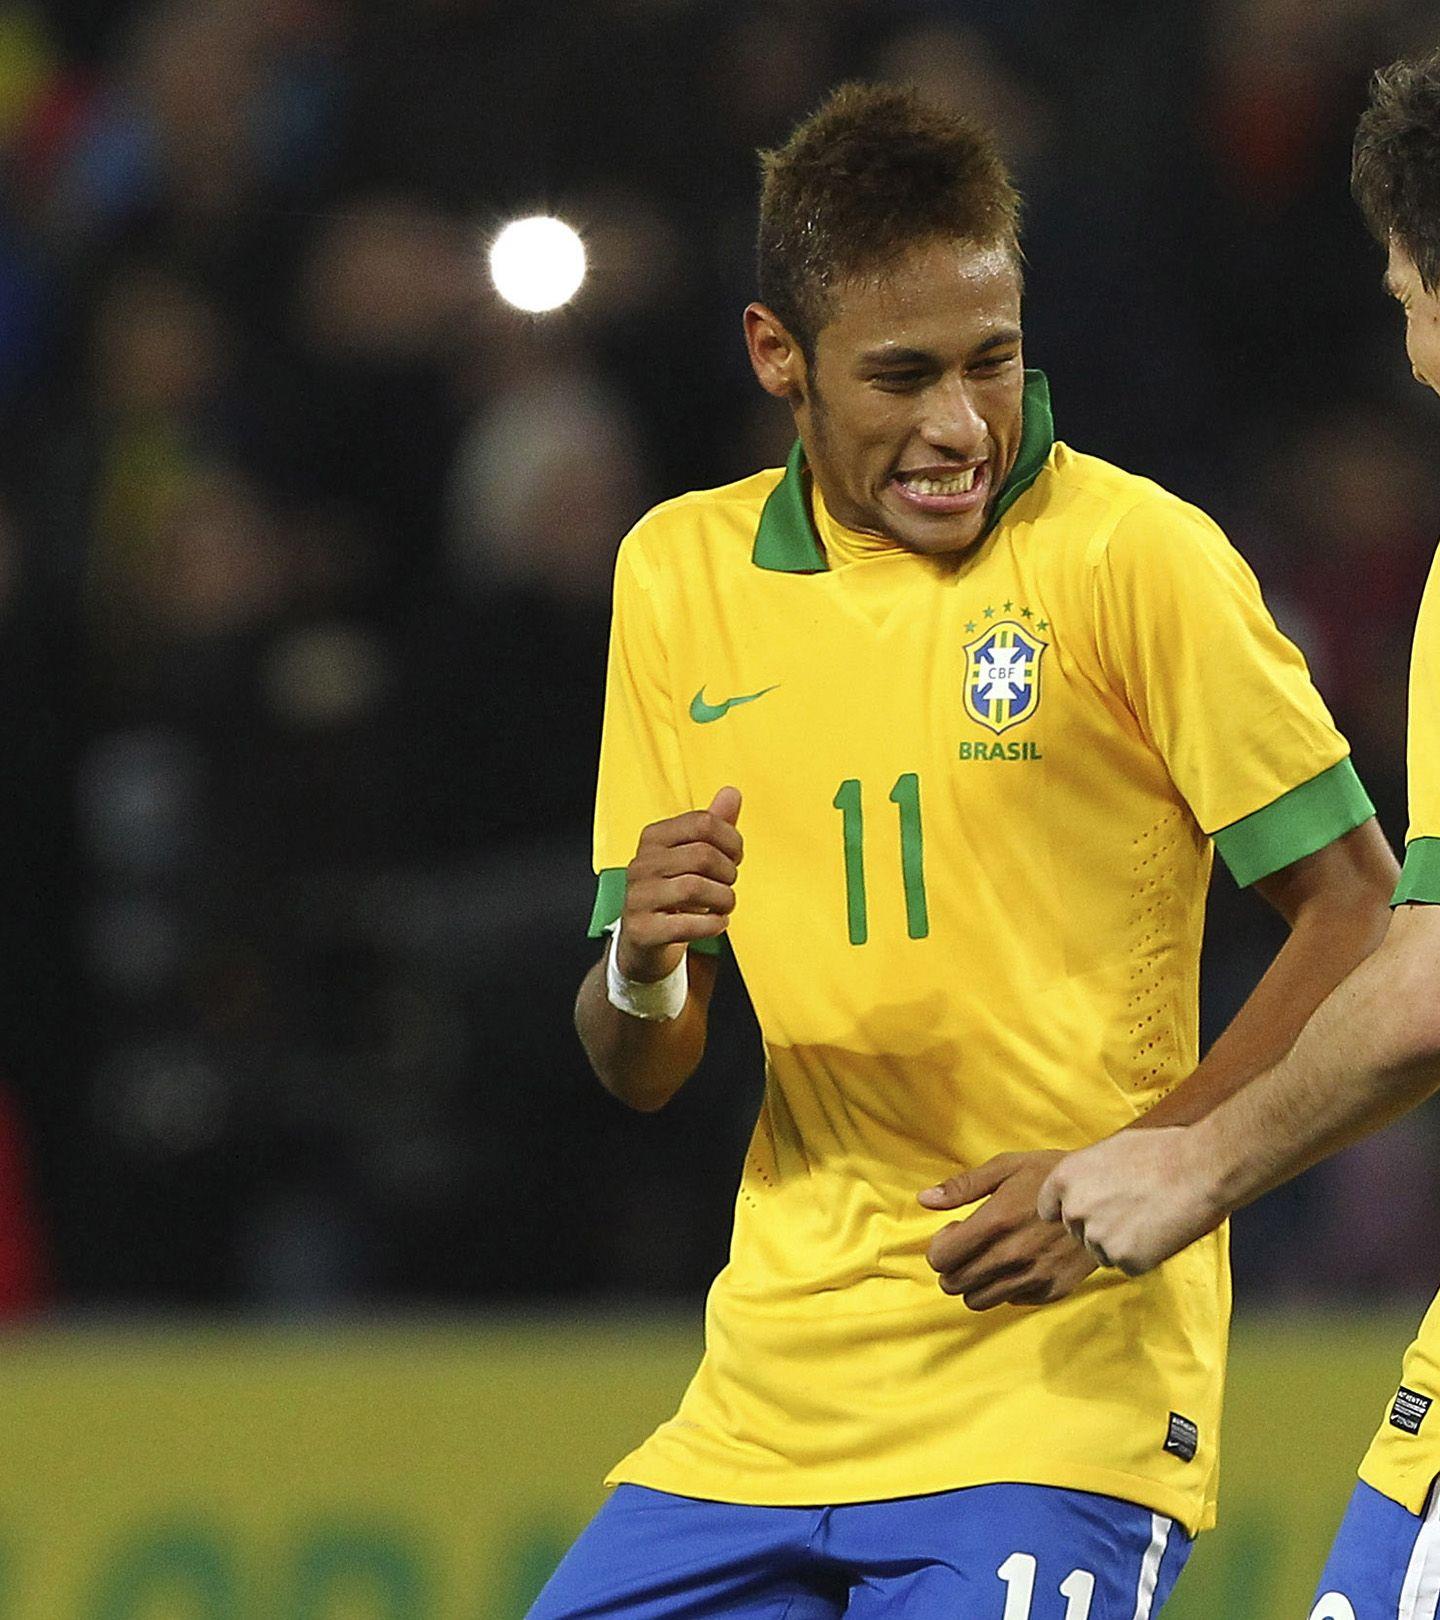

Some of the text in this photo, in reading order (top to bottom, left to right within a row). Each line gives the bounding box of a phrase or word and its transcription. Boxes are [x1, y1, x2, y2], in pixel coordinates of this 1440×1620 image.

[988, 666, 1016, 680] CBF
[959, 741, 1043, 761] BRASIL
[833, 773, 929, 945] 11
